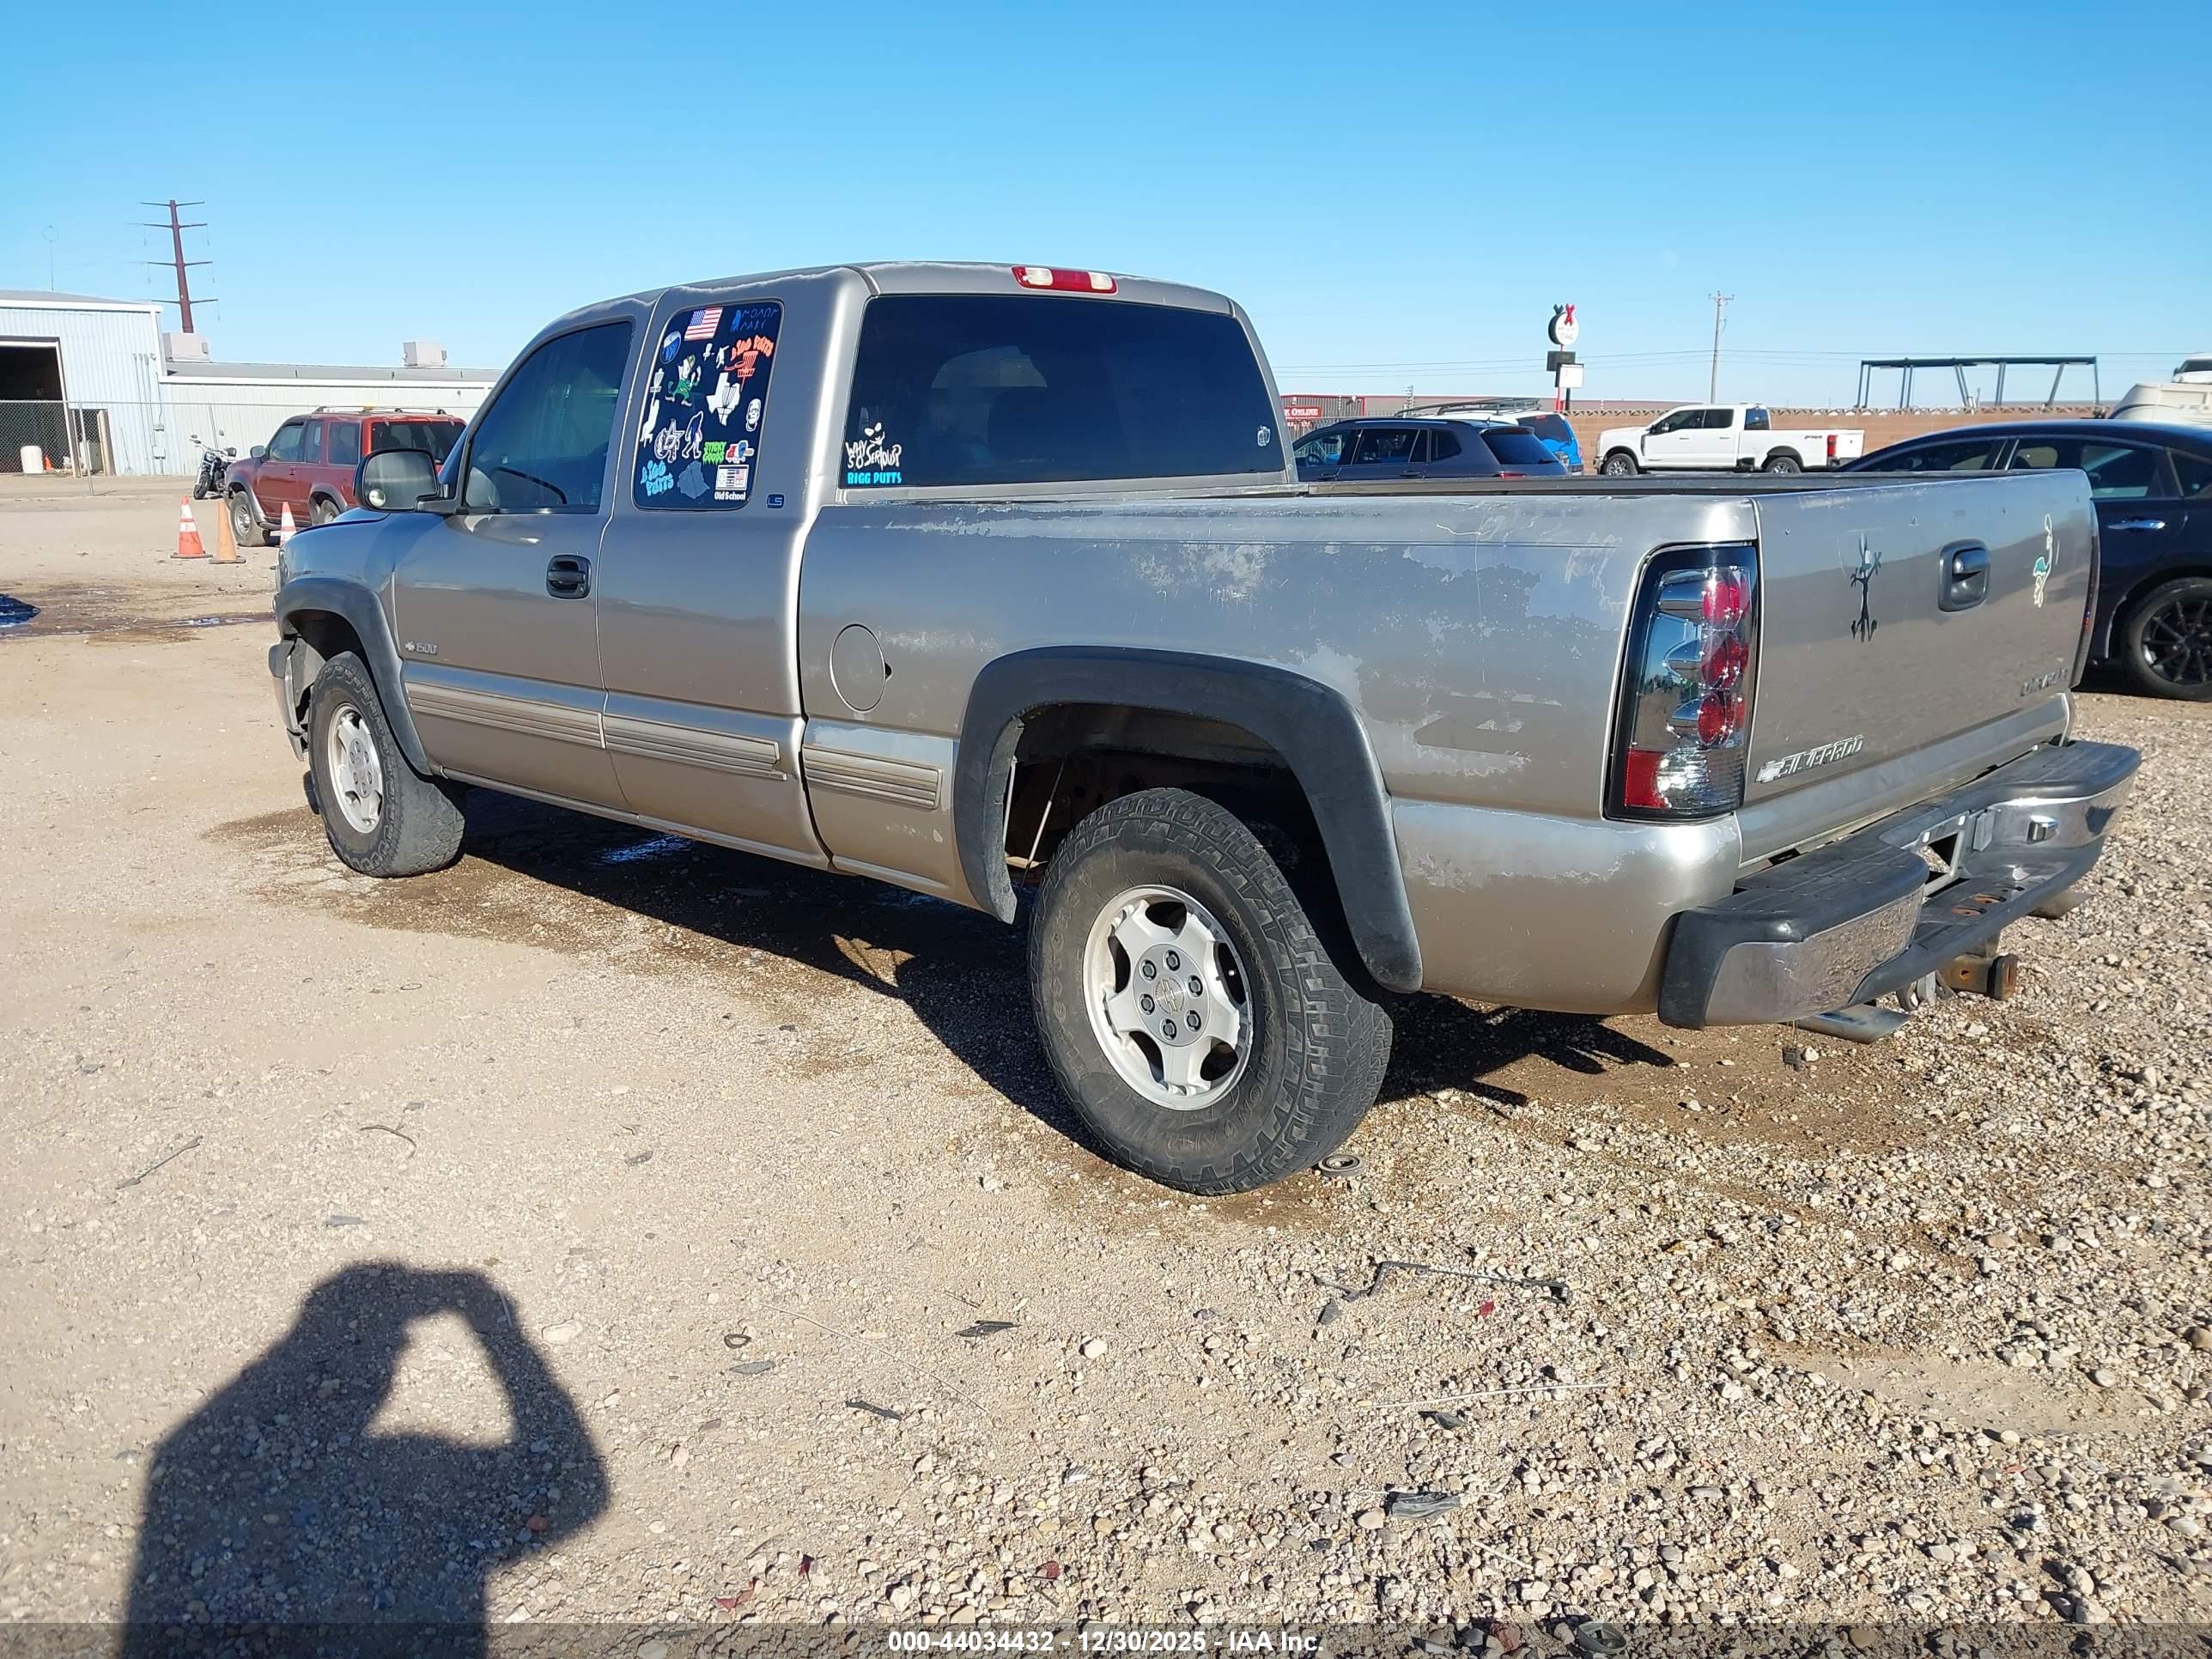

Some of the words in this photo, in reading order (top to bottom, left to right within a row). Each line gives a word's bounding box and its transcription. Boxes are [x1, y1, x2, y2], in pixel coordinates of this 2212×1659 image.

[845, 439, 867, 457] WHY
[848, 455, 864, 469] SO
[848, 471, 871, 483] BIGG
[873, 471, 902, 483] PUTTS
[714, 491, 725, 501] Old
[725, 491, 746, 501] School
[768, 497, 783, 506] LS
